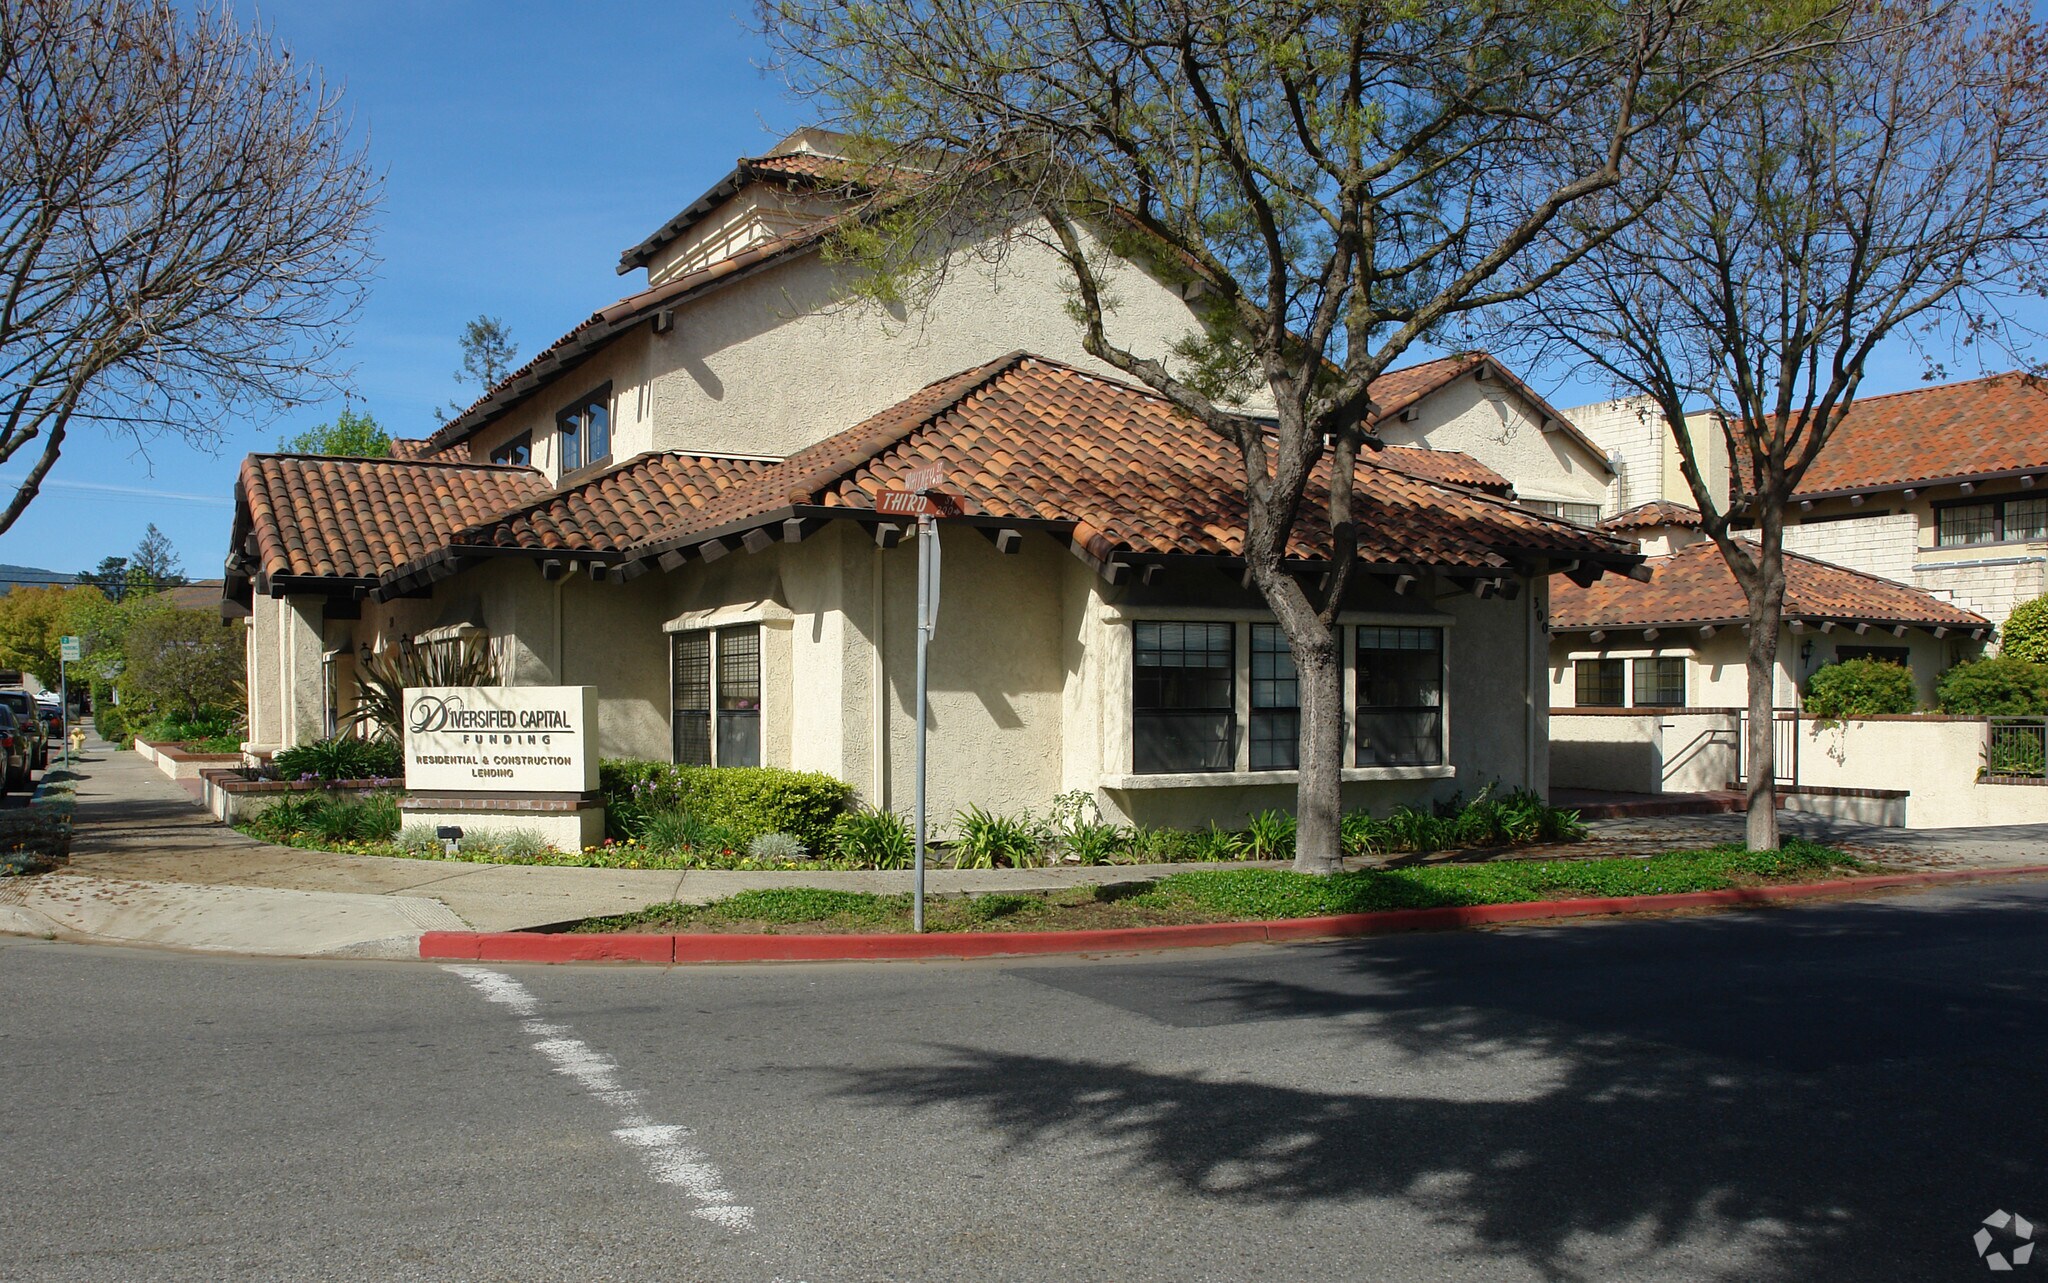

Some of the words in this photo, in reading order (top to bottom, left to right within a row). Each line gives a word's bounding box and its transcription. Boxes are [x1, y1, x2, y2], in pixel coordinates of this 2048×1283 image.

[883, 493, 928, 513] THIRD
[945, 496, 956, 505] ST
[936, 505, 954, 516] 200
[410, 695, 516, 734] DIVERSIFIED
[520, 710, 571, 729] CAPITAL
[463, 735, 551, 745] FUNDING
[416, 755, 478, 765] RESIDENTIAL
[482, 755, 490, 765] &
[493, 755, 571, 766] CONSTRUCTION
[472, 768, 514, 778] LENDING
